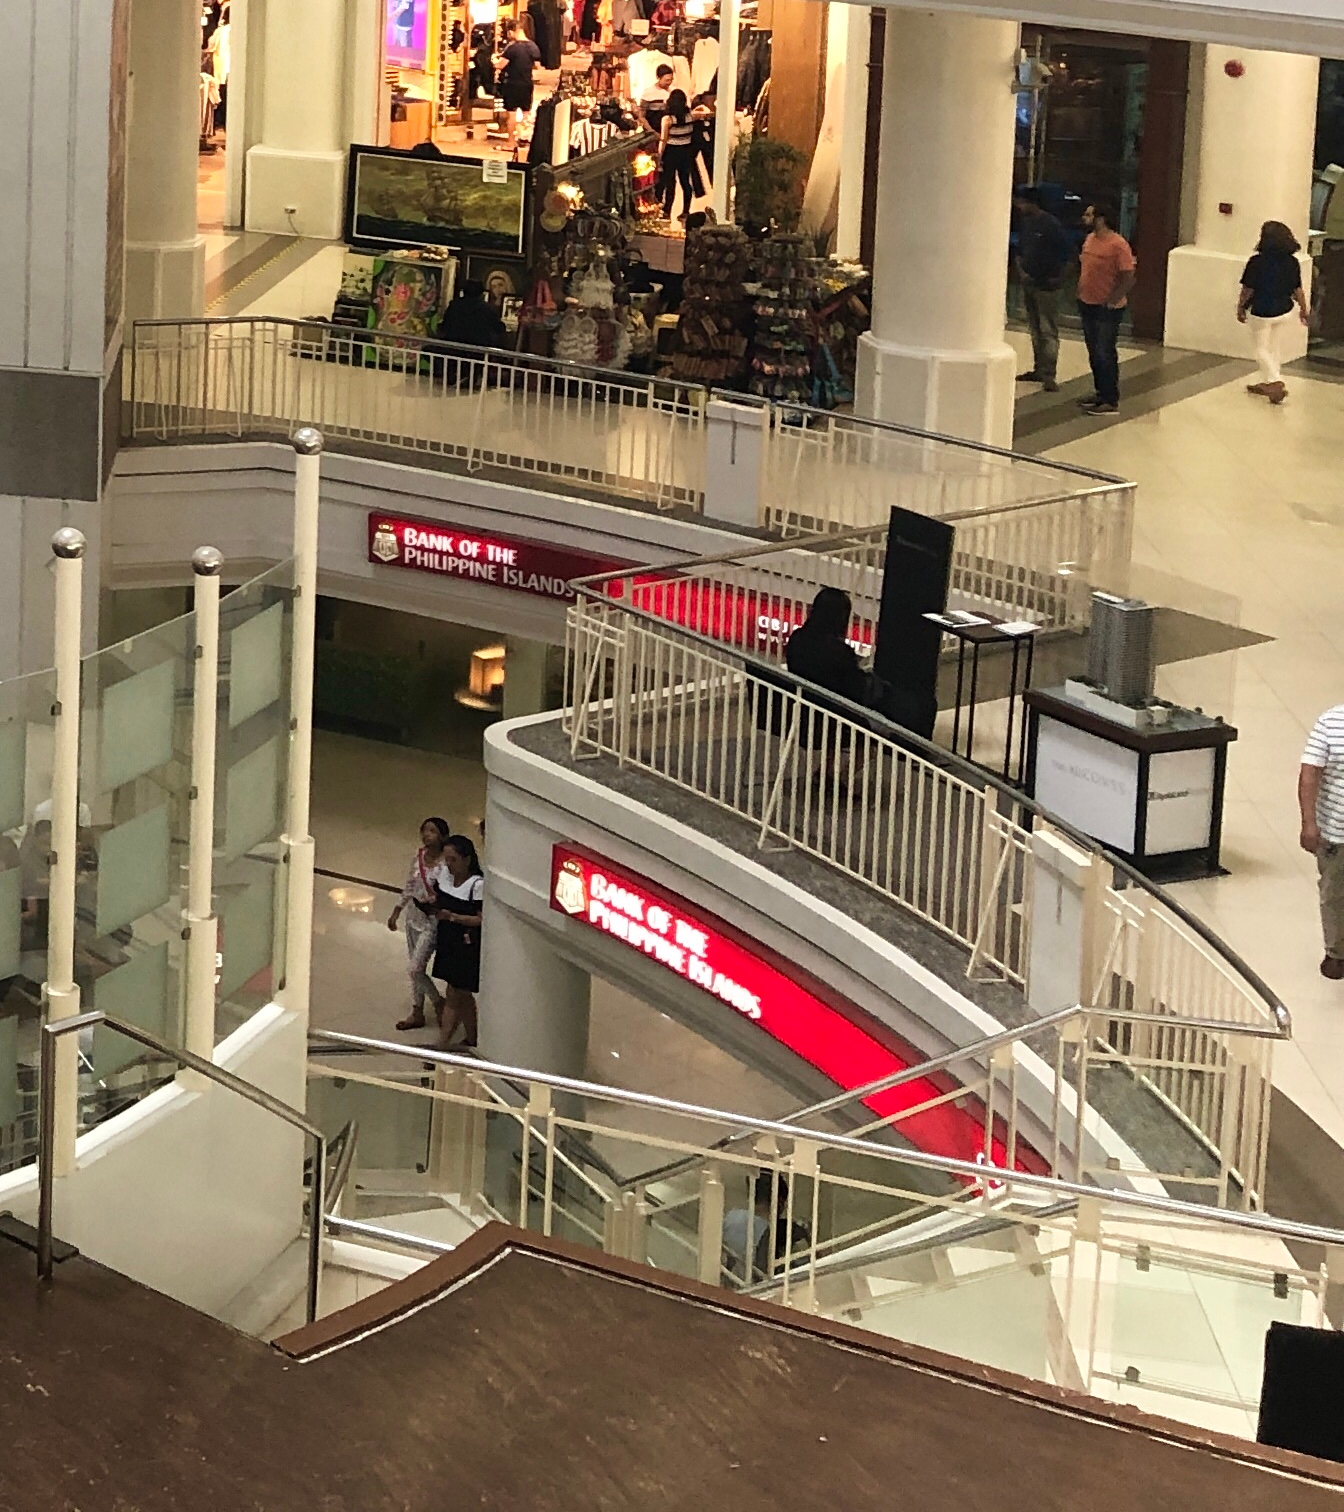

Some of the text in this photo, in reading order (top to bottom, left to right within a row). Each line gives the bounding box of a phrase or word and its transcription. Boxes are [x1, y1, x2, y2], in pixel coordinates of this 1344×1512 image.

[404, 528, 518, 566] BANK OF THE
[404, 547, 575, 598] PHILIPPINE ISLANDS
[590, 873, 709, 959] BANK OF THE
[589, 899, 762, 1020] PHILIPPINE ISLANDS
